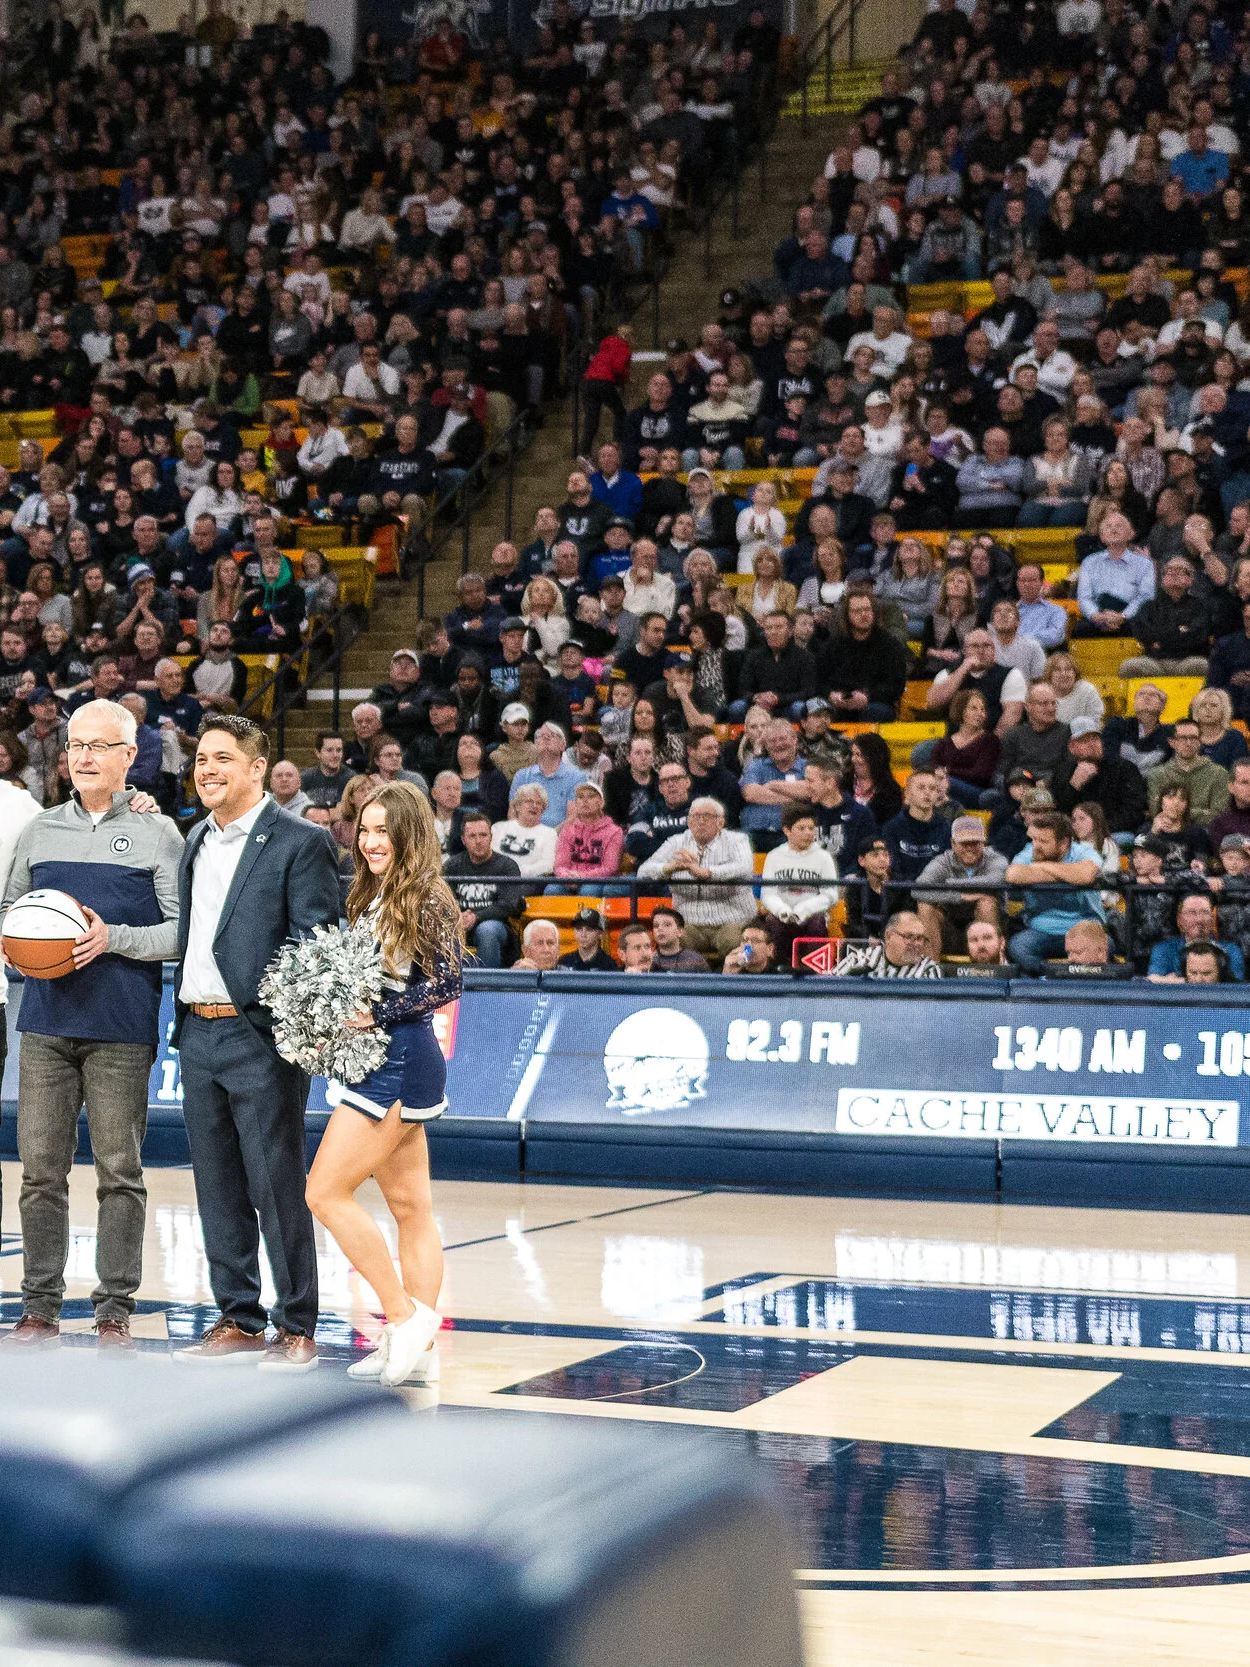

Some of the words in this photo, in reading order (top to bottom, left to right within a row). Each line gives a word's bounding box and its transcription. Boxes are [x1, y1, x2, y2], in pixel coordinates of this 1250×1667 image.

[809, 1021, 861, 1066] FM
[991, 1025, 1083, 1073] 1340
[1088, 1028, 1146, 1074] AM
[847, 1095, 1022, 1134] CACHE
[1036, 1102, 1228, 1141] VALLEY
